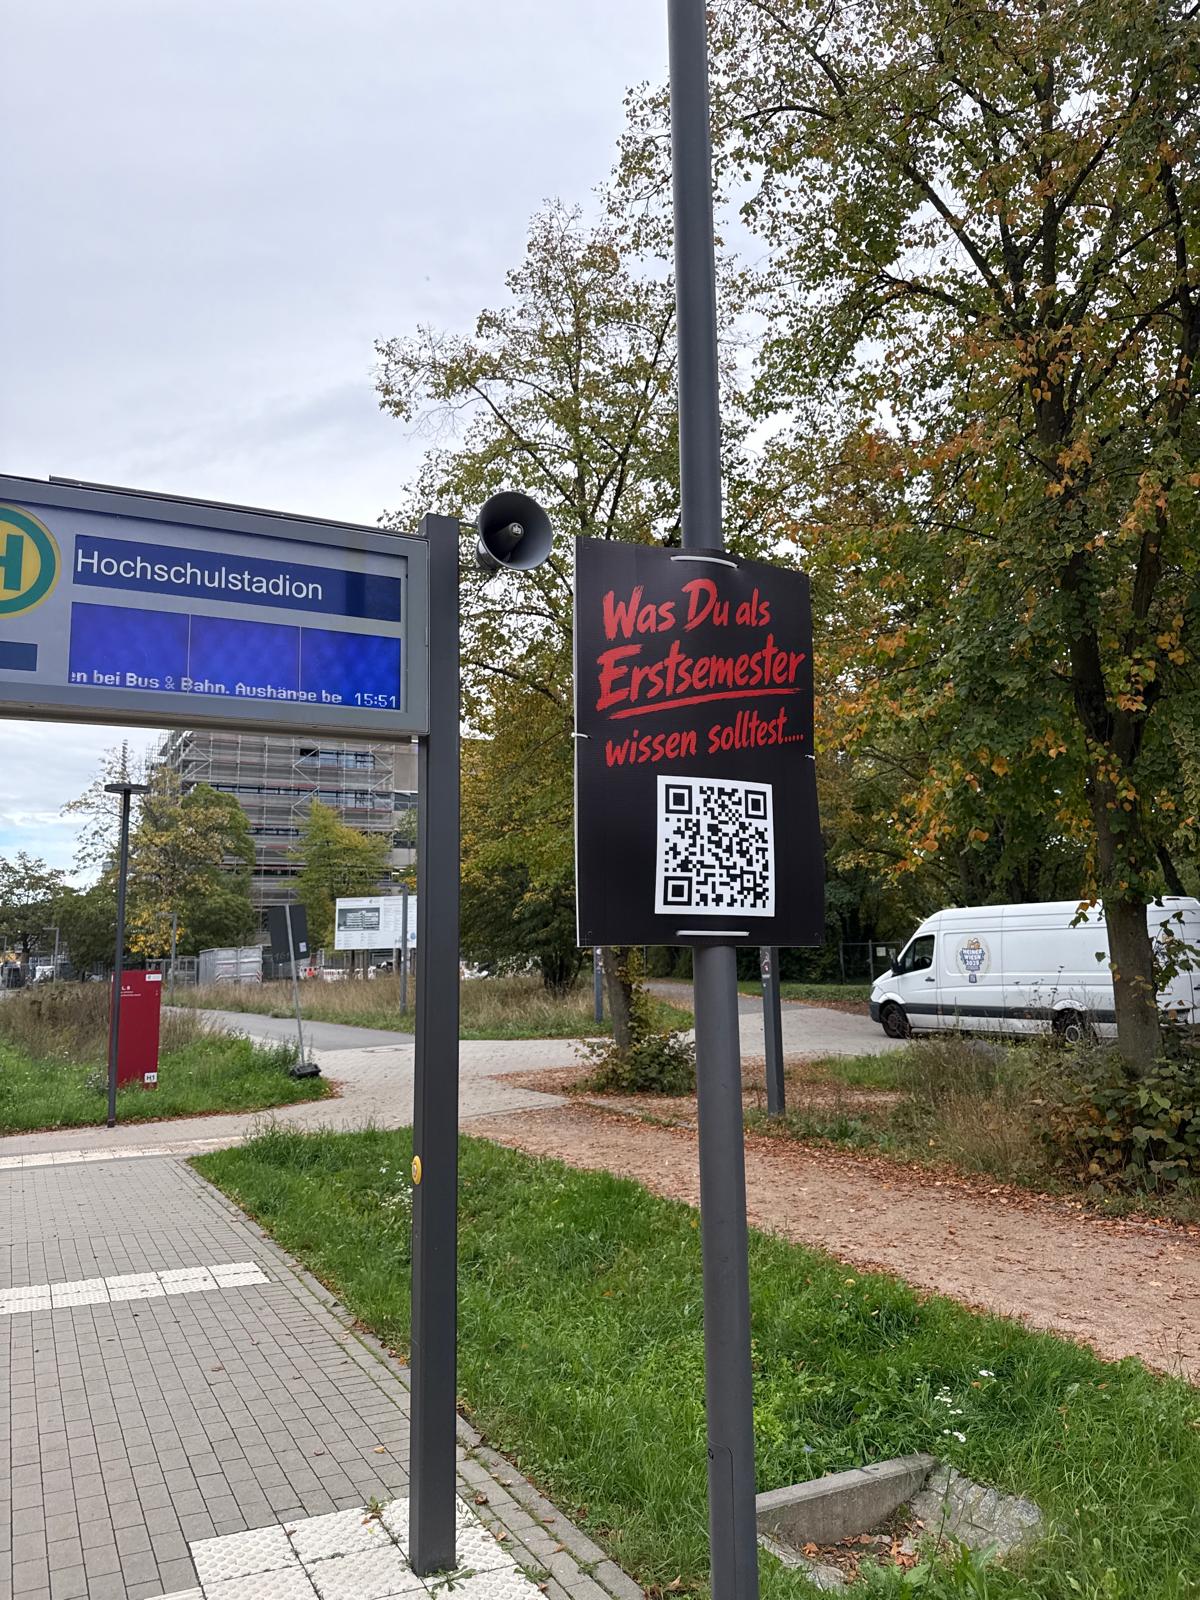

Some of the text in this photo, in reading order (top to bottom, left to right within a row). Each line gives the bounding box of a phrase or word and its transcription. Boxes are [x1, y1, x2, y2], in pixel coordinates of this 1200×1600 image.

[77, 549, 322, 600] Hochschulstadion
[603, 578, 771, 640] Was Du als
[93, 670, 120, 686] bei
[125, 672, 160, 690] Bus
[164, 675, 176, 690] &
[181, 677, 230, 695] Bahn.
[235, 682, 318, 703] Aushänge
[321, 689, 342, 704] be
[596, 633, 806, 712] Erstsemester
[354, 692, 397, 709] 15:51
[605, 728, 697, 768] wissen
